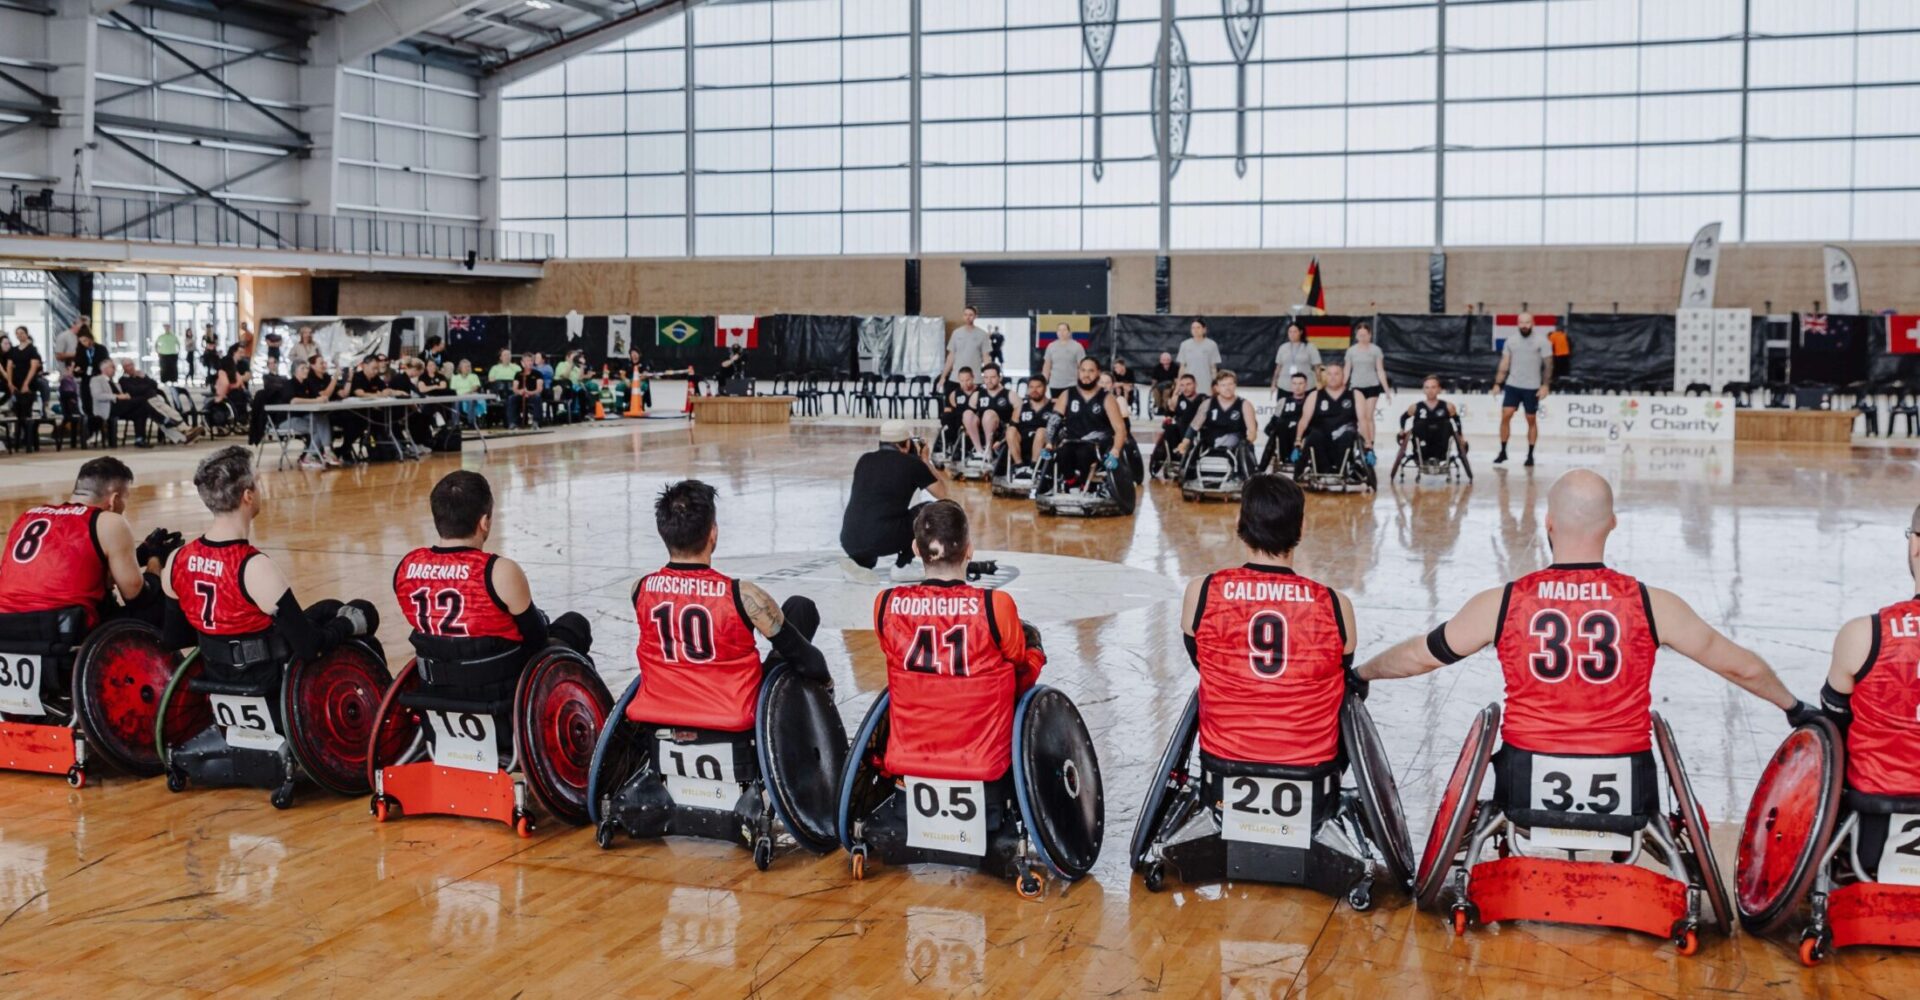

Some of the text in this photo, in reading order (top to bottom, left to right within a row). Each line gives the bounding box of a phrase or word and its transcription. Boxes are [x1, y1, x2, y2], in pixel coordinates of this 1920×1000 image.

[1021, 411, 1033, 422] 15
[1070, 399, 1080, 413] 6
[1211, 408, 1219, 421] 1
[1419, 407, 1428, 418] 2
[1567, 402, 1604, 415] Pub
[1651, 403, 1688, 416] Pub
[1567, 416, 1635, 433] Chary
[1650, 417, 1720, 433] Charity
[12, 518, 51, 563] 8
[187, 555, 224, 578] GREEN
[406, 562, 470, 580] DAGENAIS
[645, 575, 727, 597] HIRSCHFIELD
[1223, 581, 1315, 602] CALDWELL
[1538, 581, 1613, 601] MADELL
[194, 580, 217, 629] 7
[409, 586, 470, 637] 12
[890, 596, 979, 616] RODRIGUES
[650, 601, 716, 664] 10
[903, 624, 971, 677] 41
[1248, 609, 1288, 679] 9
[1528, 608, 1622, 685] 33
[669, 750, 723, 781] 10
[913, 782, 977, 821] 0.5
[1232, 776, 1302, 817] 2.0
[1541, 771, 1620, 814] 3.5
